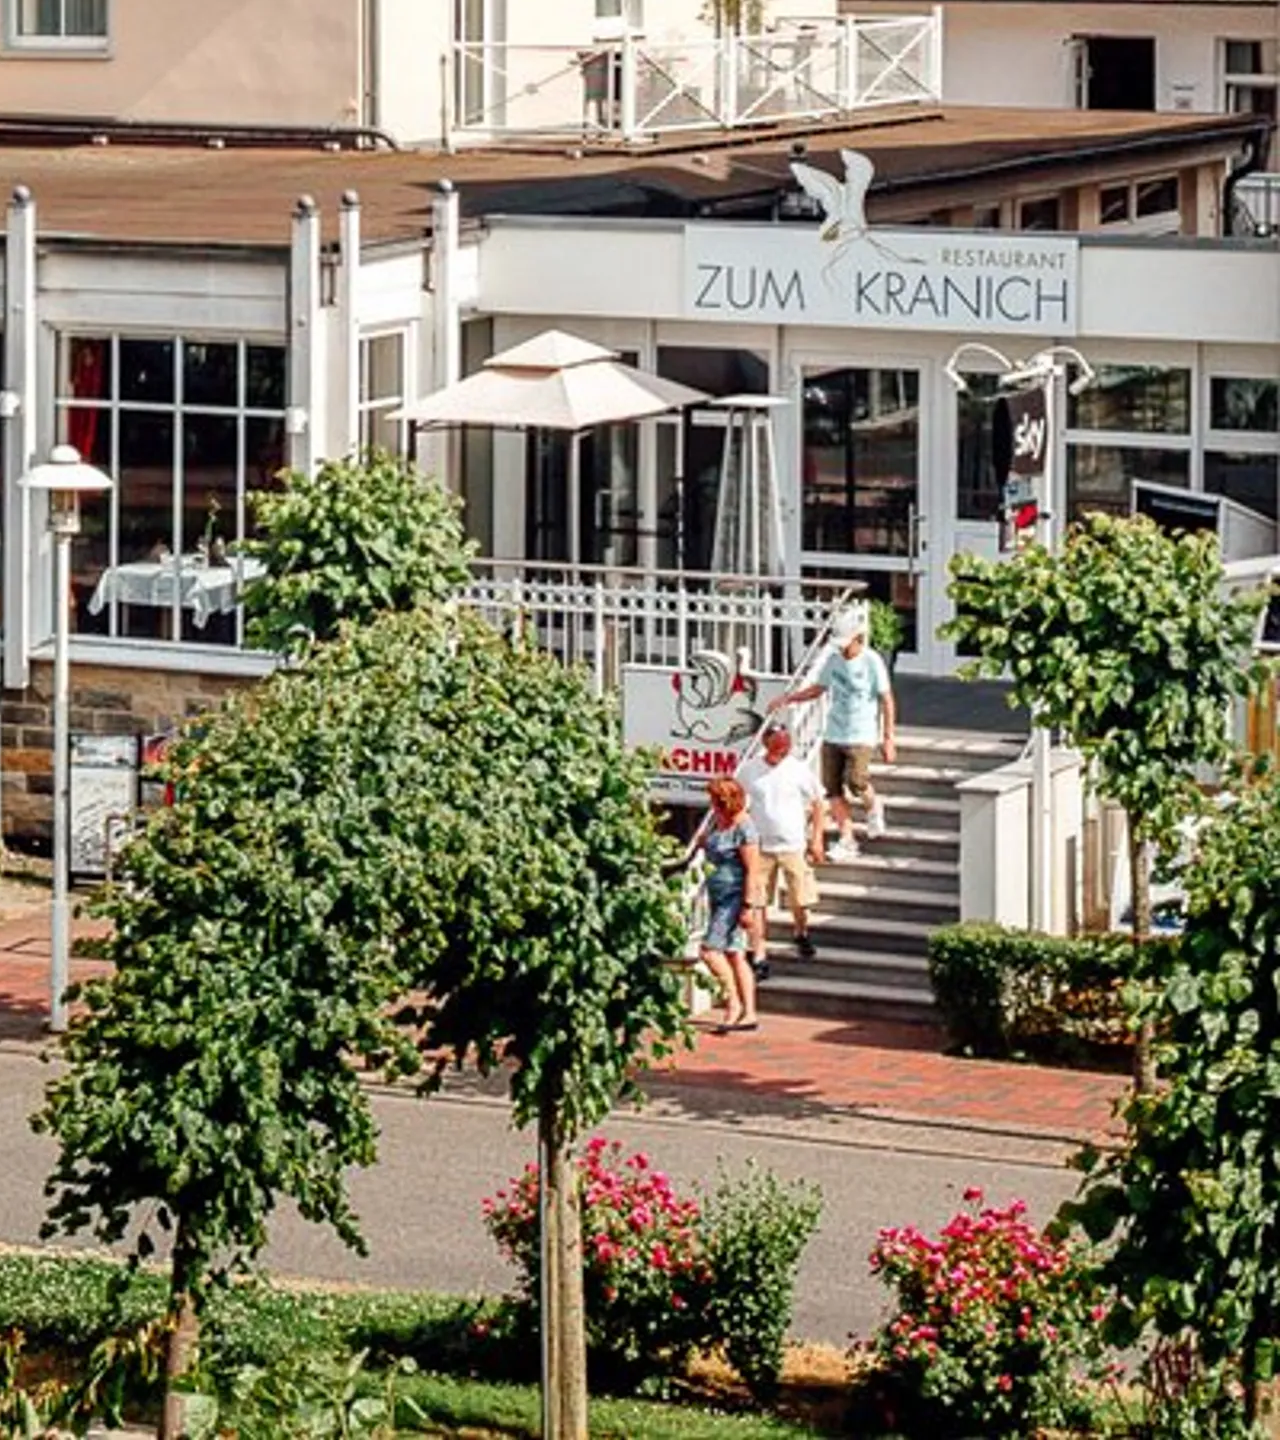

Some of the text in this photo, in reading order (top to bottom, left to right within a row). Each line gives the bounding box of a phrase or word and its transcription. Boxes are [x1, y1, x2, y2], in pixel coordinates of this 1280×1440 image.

[941, 247, 1066, 269] RESTAURANT
[694, 265, 1069, 323] ZUM KRANICH
[1014, 412, 1045, 460] sky
